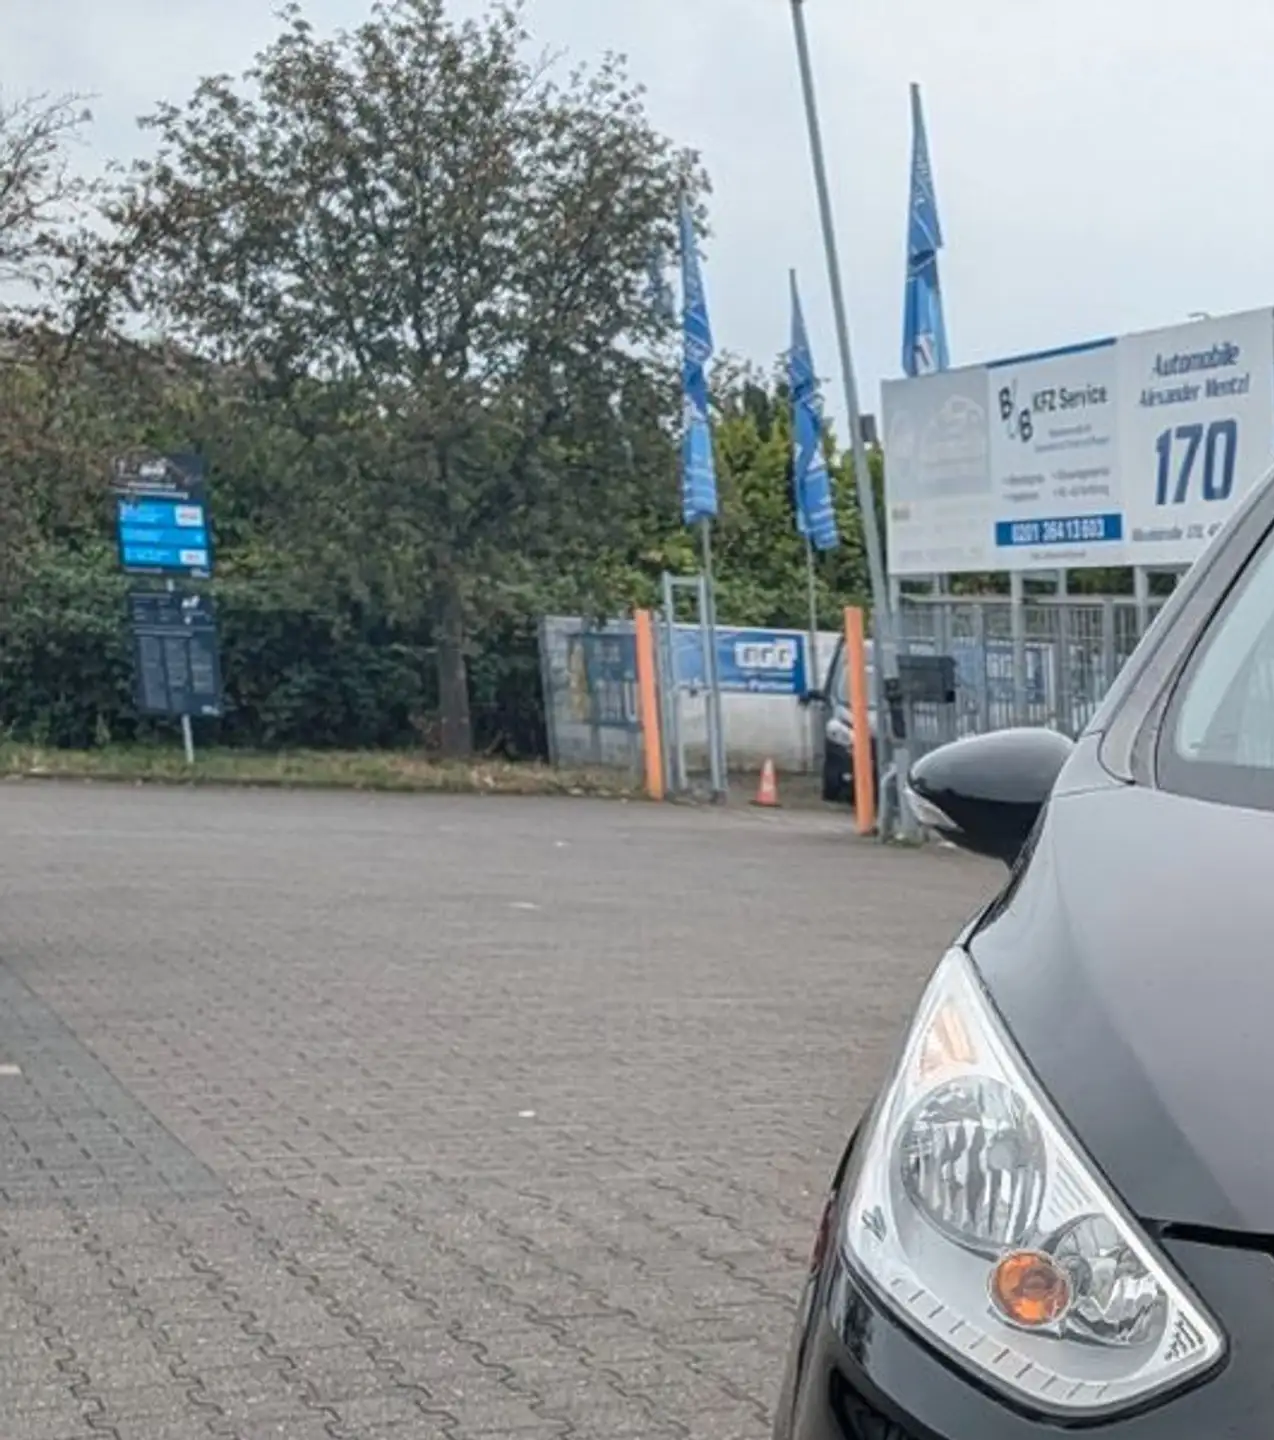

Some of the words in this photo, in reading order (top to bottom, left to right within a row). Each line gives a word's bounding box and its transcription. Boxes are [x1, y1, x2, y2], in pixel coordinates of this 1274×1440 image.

[1032, 389, 1057, 413] KFZ
[1058, 384, 1108, 410] Service
[1155, 418, 1238, 506] 170
